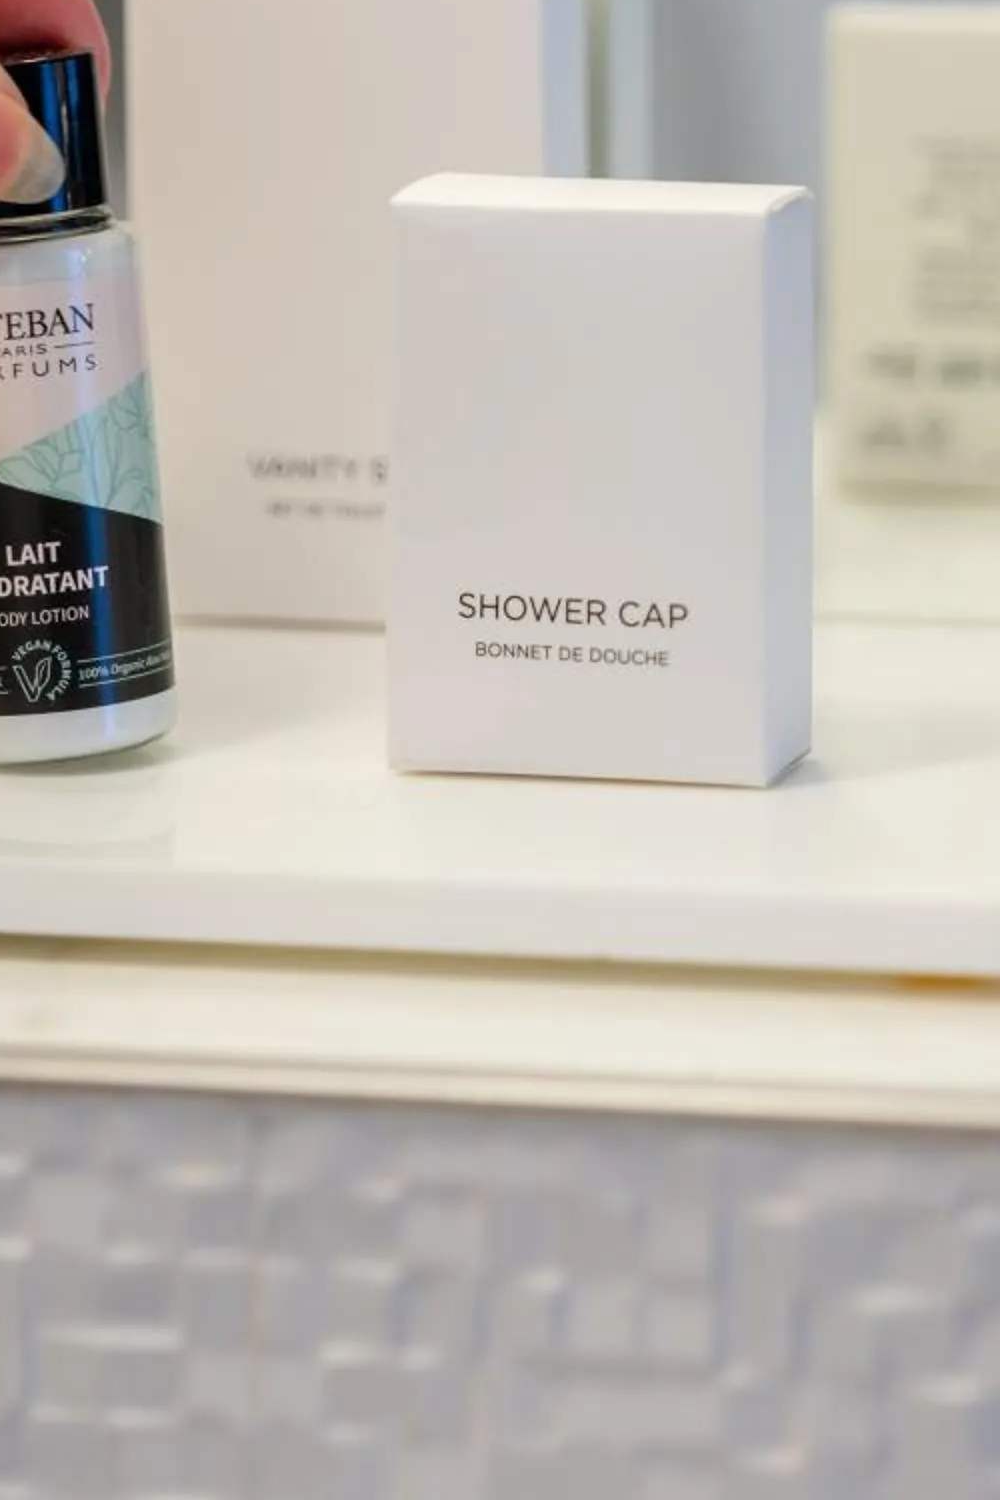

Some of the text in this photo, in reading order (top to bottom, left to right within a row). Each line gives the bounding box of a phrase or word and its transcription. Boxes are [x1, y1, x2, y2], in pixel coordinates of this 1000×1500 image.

[248, 453, 359, 481] VANITY
[5, 541, 62, 567] LAIT
[31, 605, 90, 625] LOTION
[458, 592, 689, 629] SHOWER CAP
[475, 641, 671, 667] BONNET DE DOUCHE
[11, 639, 73, 701] VEGAN FORMULA
[79, 665, 109, 681] 100%
